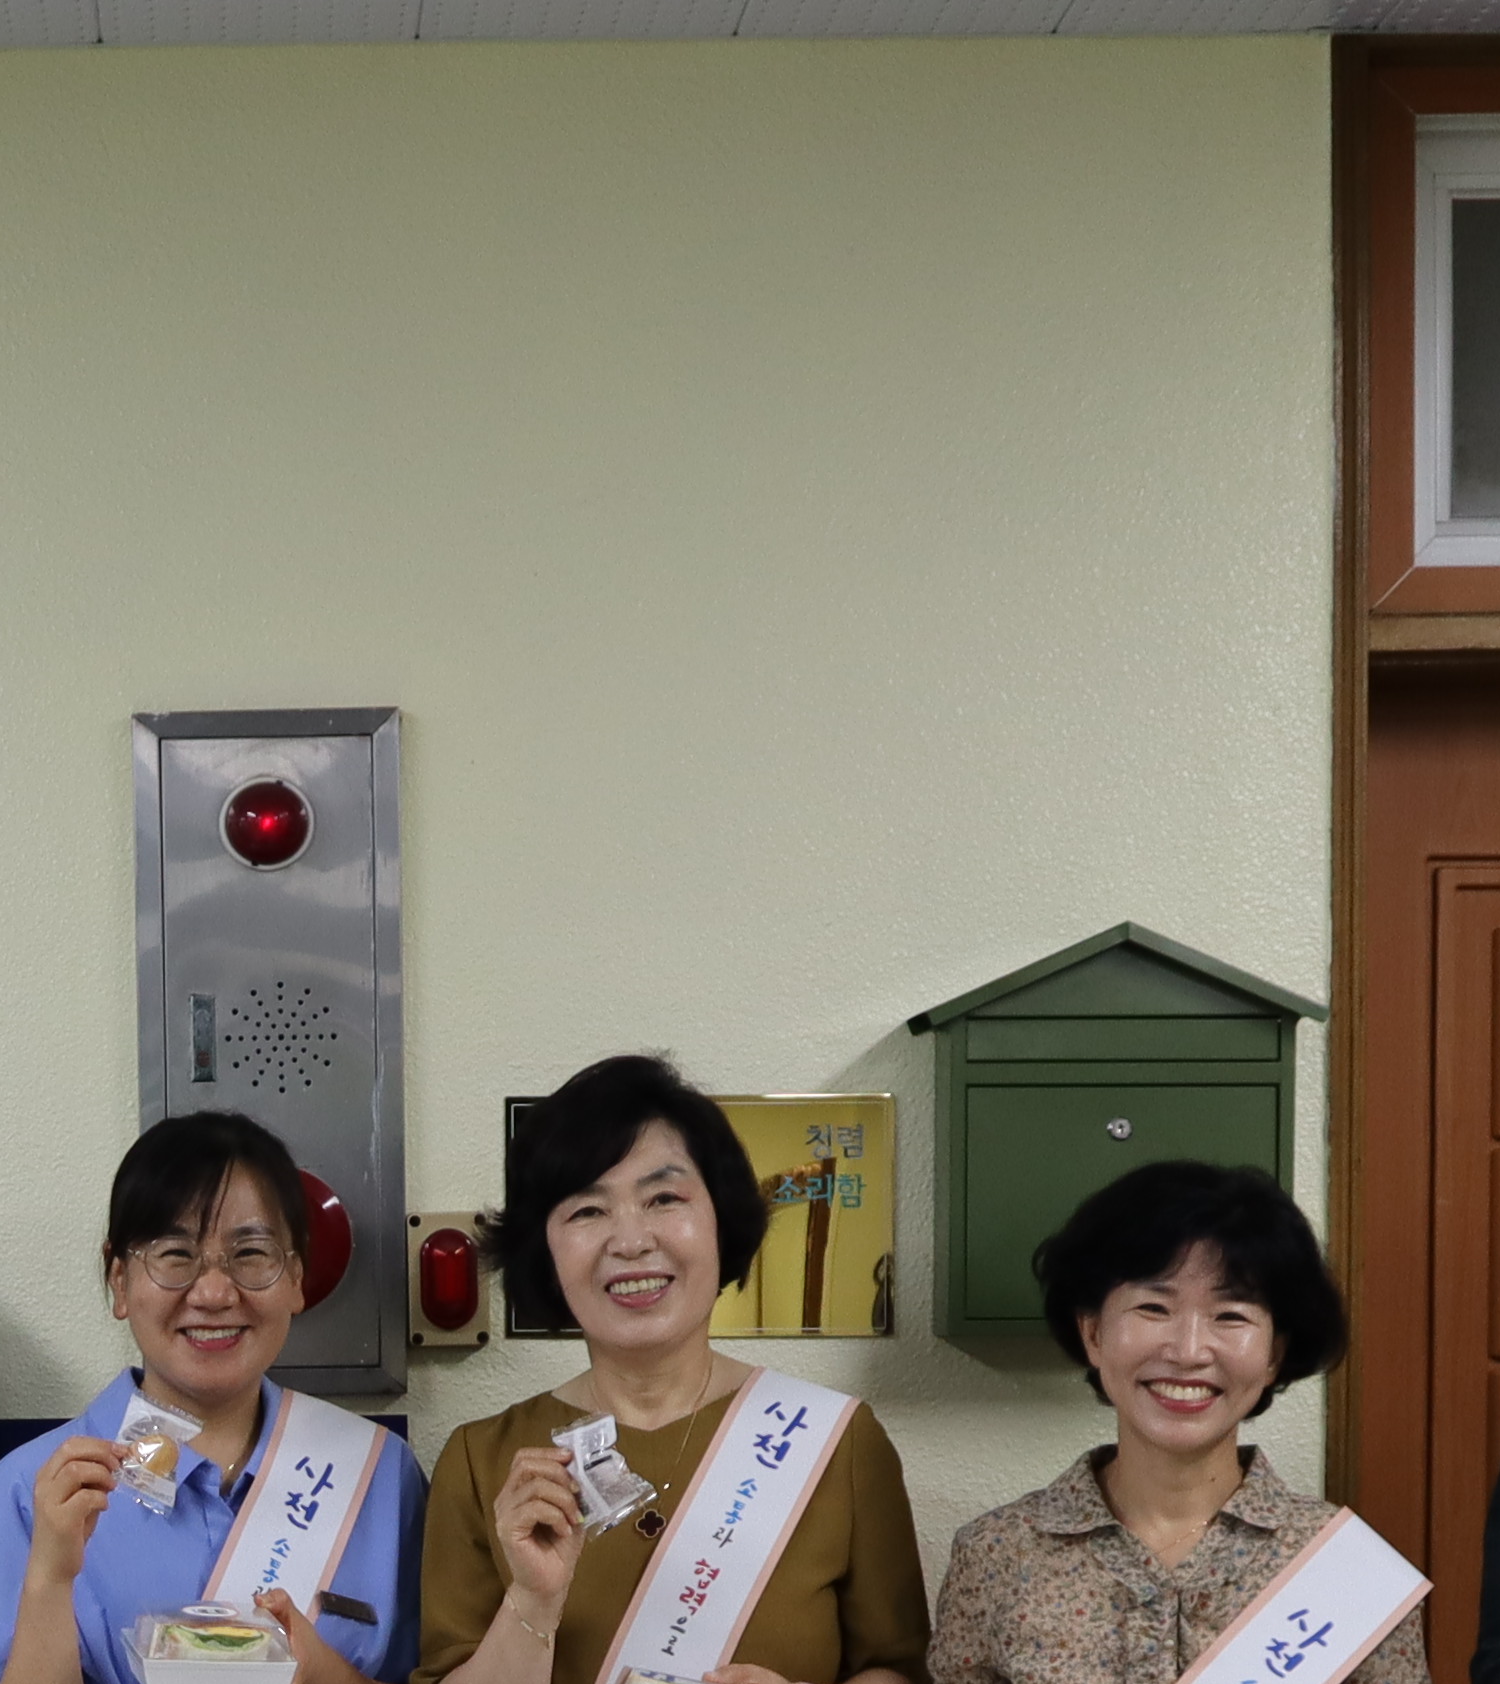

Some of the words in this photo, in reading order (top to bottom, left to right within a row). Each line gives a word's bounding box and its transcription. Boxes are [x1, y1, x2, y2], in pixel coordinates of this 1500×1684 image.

[805, 1122, 864, 1160] 청렴
[770, 1173, 867, 1209] 소리함
[752, 1400, 808, 1470] 사천
[285, 1457, 335, 1530] 사천
[711, 1478, 759, 1549] 소통과
[661, 1556, 720, 1657] 협력으로
[1265, 1607, 1334, 1679] 사천
